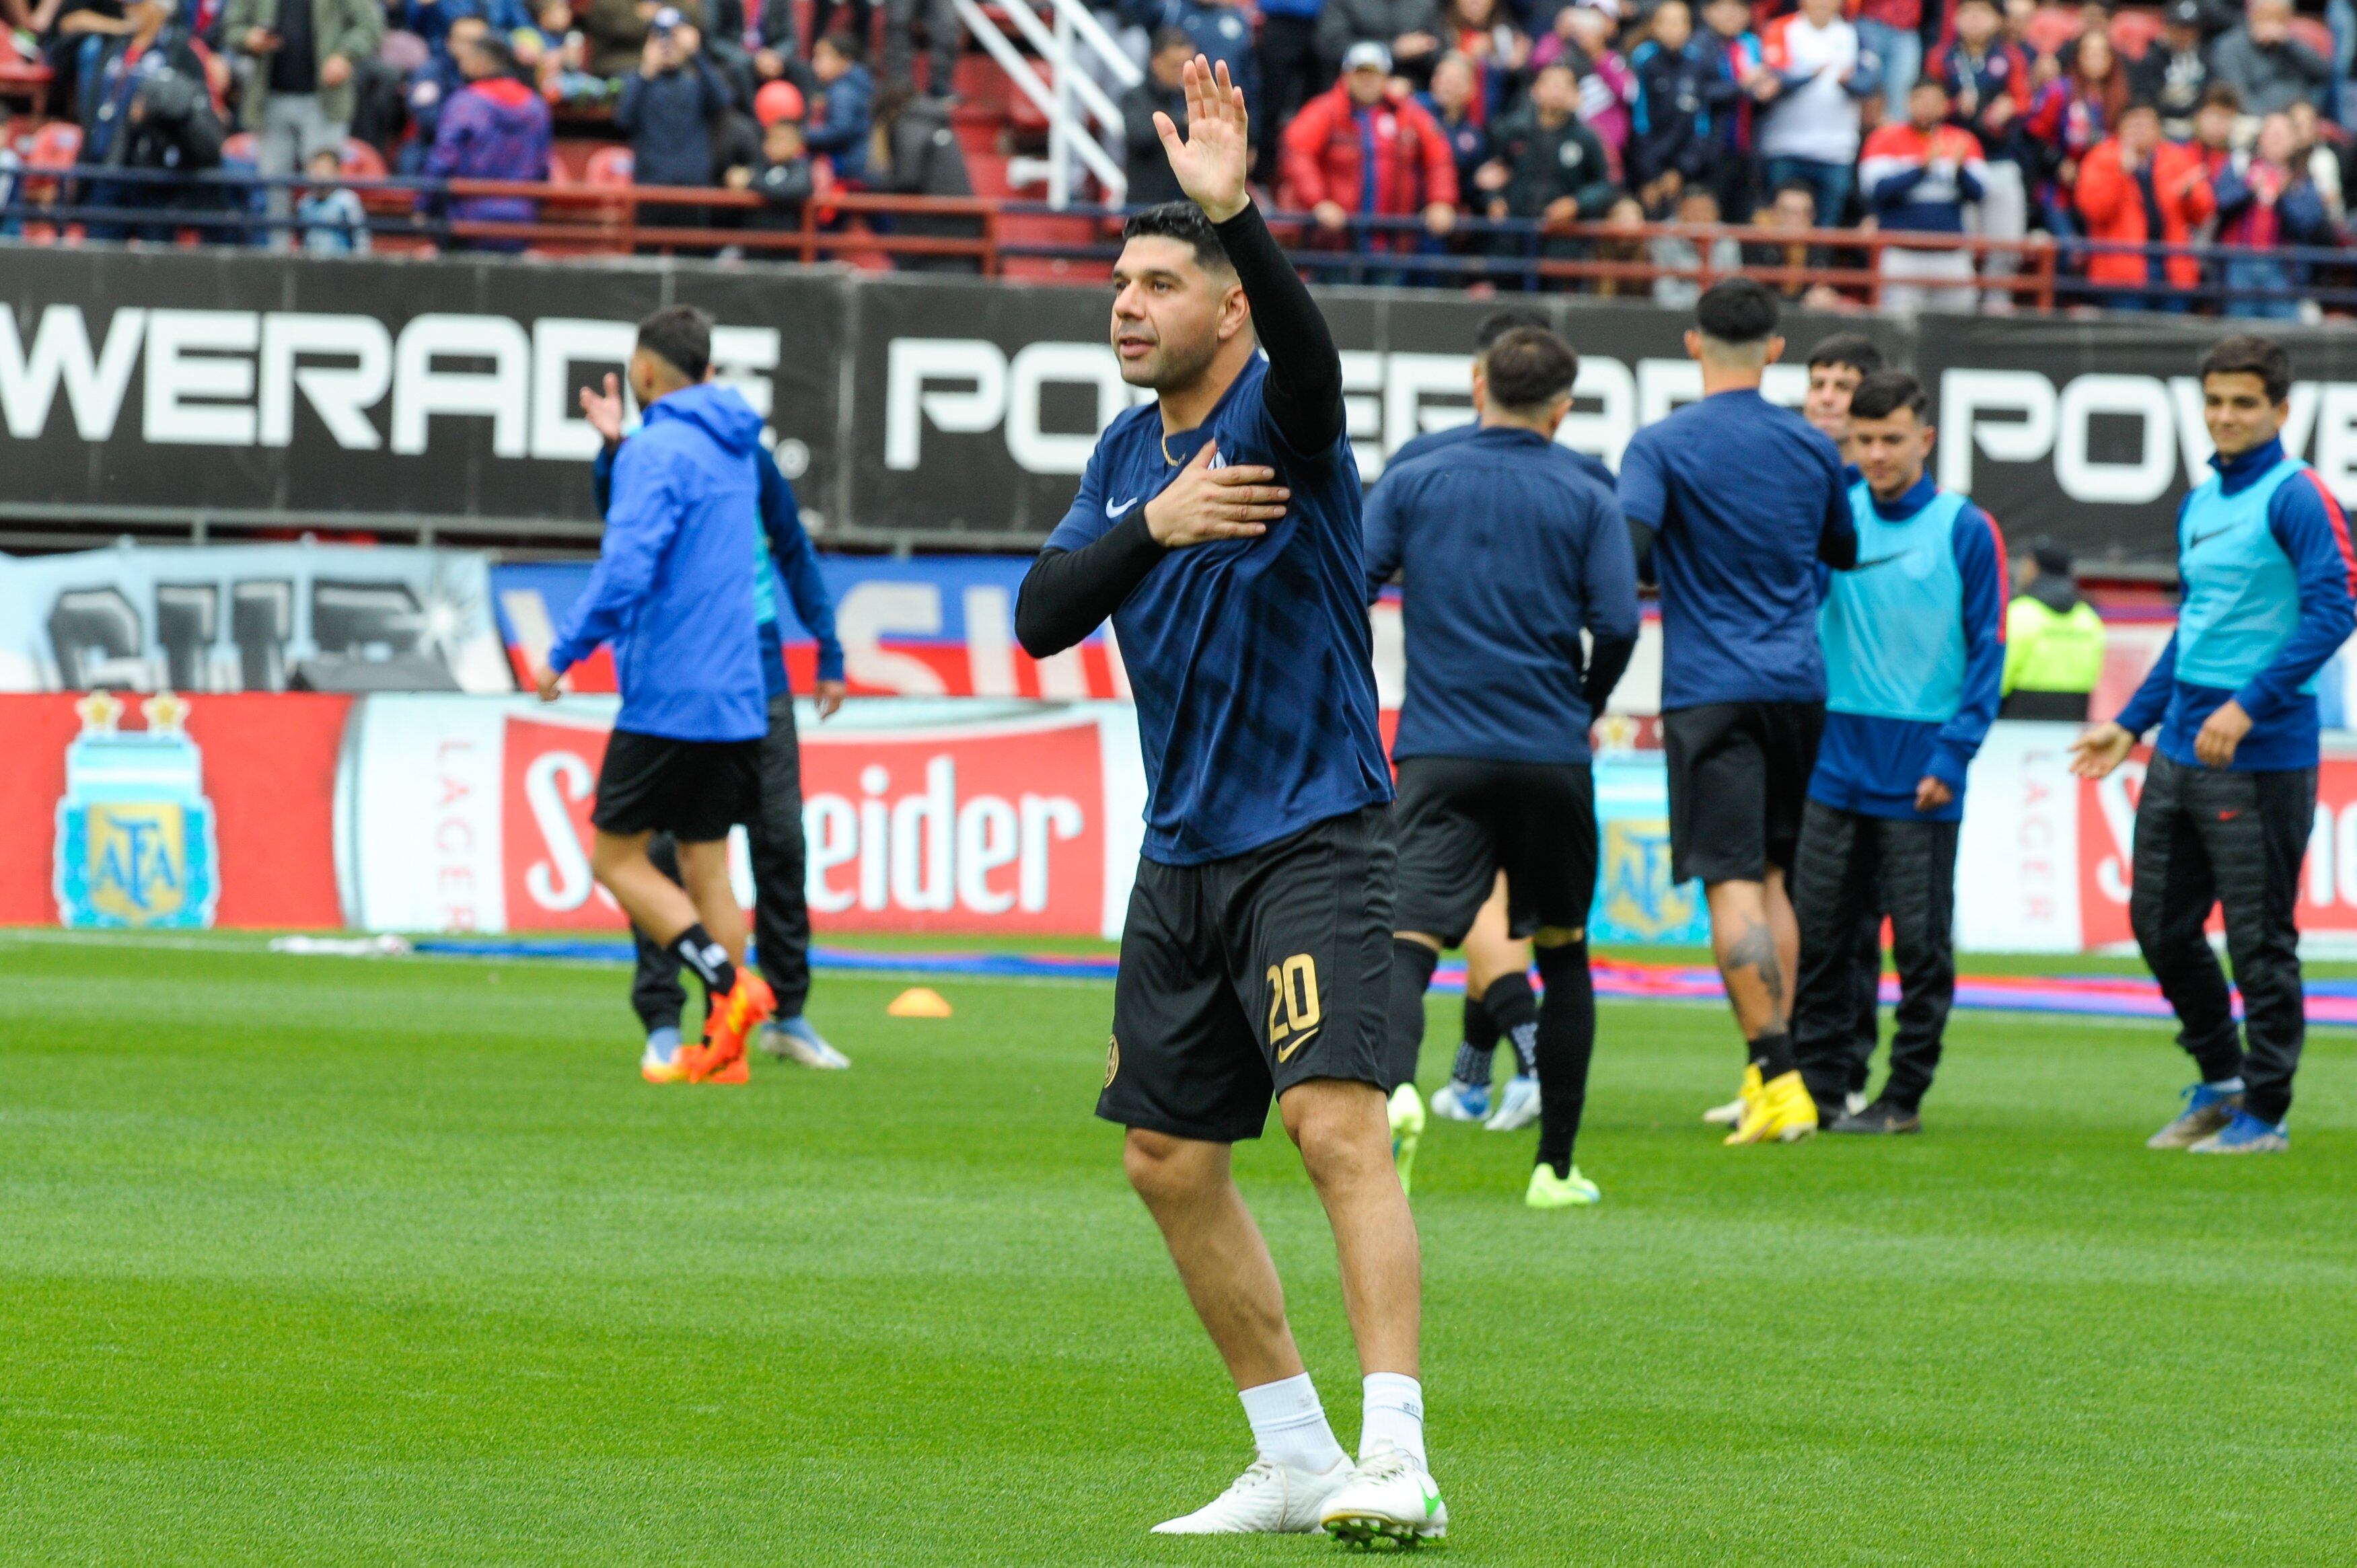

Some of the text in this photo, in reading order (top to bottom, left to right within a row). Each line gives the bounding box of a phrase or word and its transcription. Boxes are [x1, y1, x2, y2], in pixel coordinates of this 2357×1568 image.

[96, 814, 178, 910] AFA
[525, 750, 1083, 913] Seider
[1266, 953, 1320, 1045] 20
